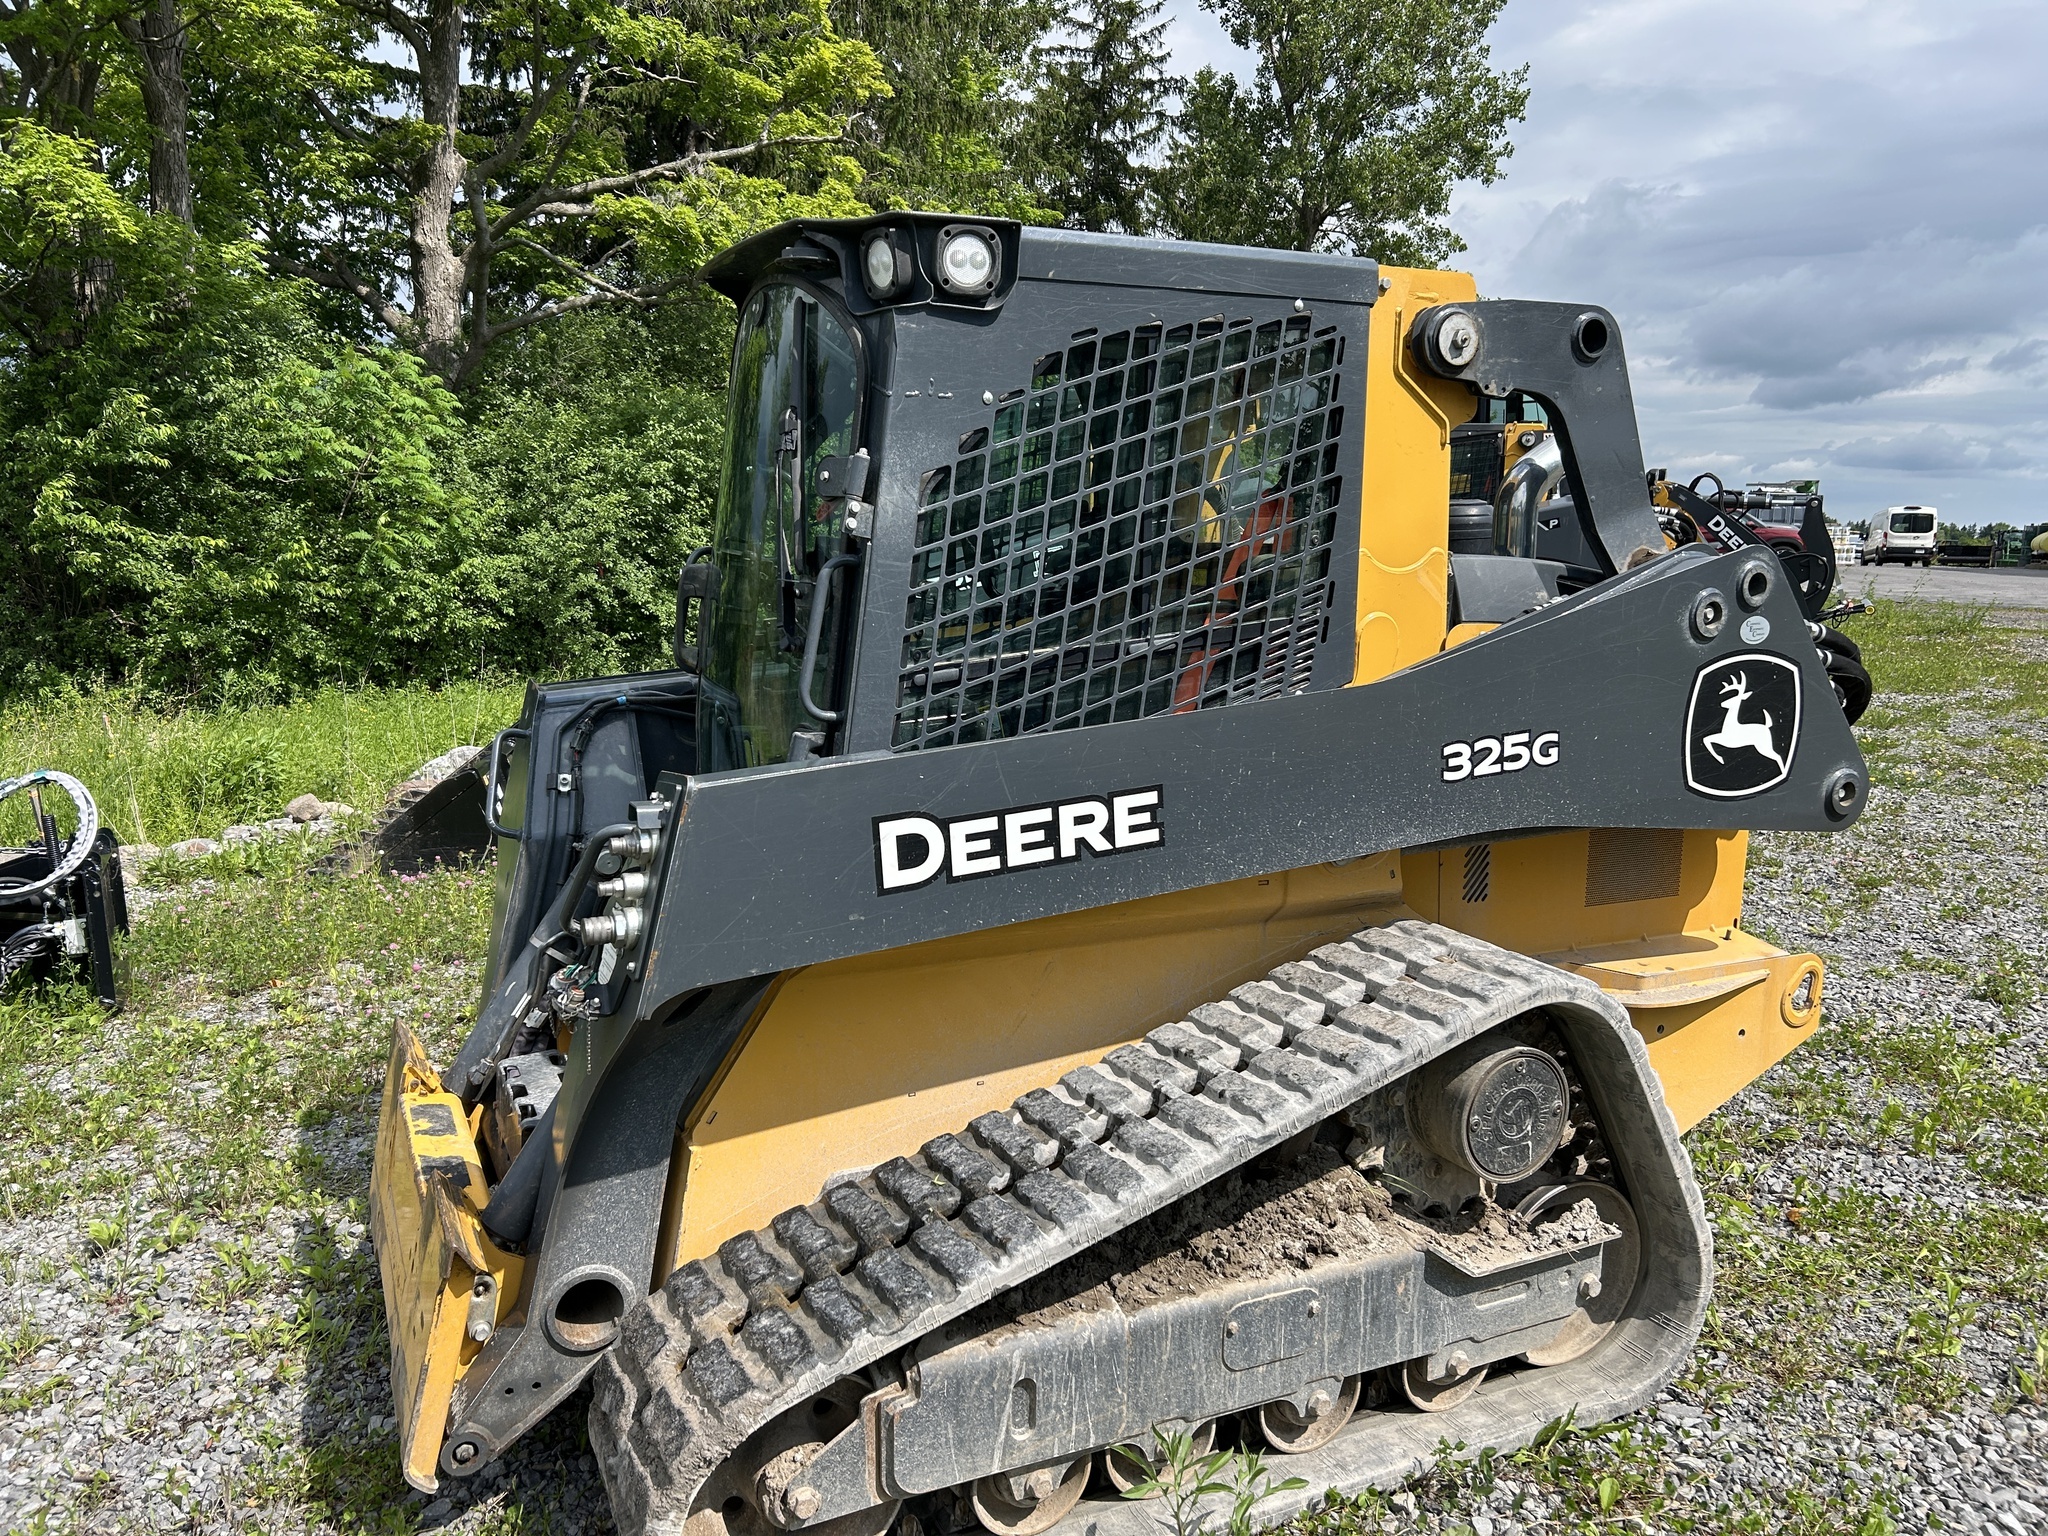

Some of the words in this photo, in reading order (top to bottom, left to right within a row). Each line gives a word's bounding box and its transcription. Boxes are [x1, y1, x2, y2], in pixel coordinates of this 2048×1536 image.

[1707, 515, 1748, 550] DEE
[1442, 731, 1560, 782] 325G
[878, 790, 1161, 890] DEERE
[1481, 1081, 1509, 1141] SPICER
